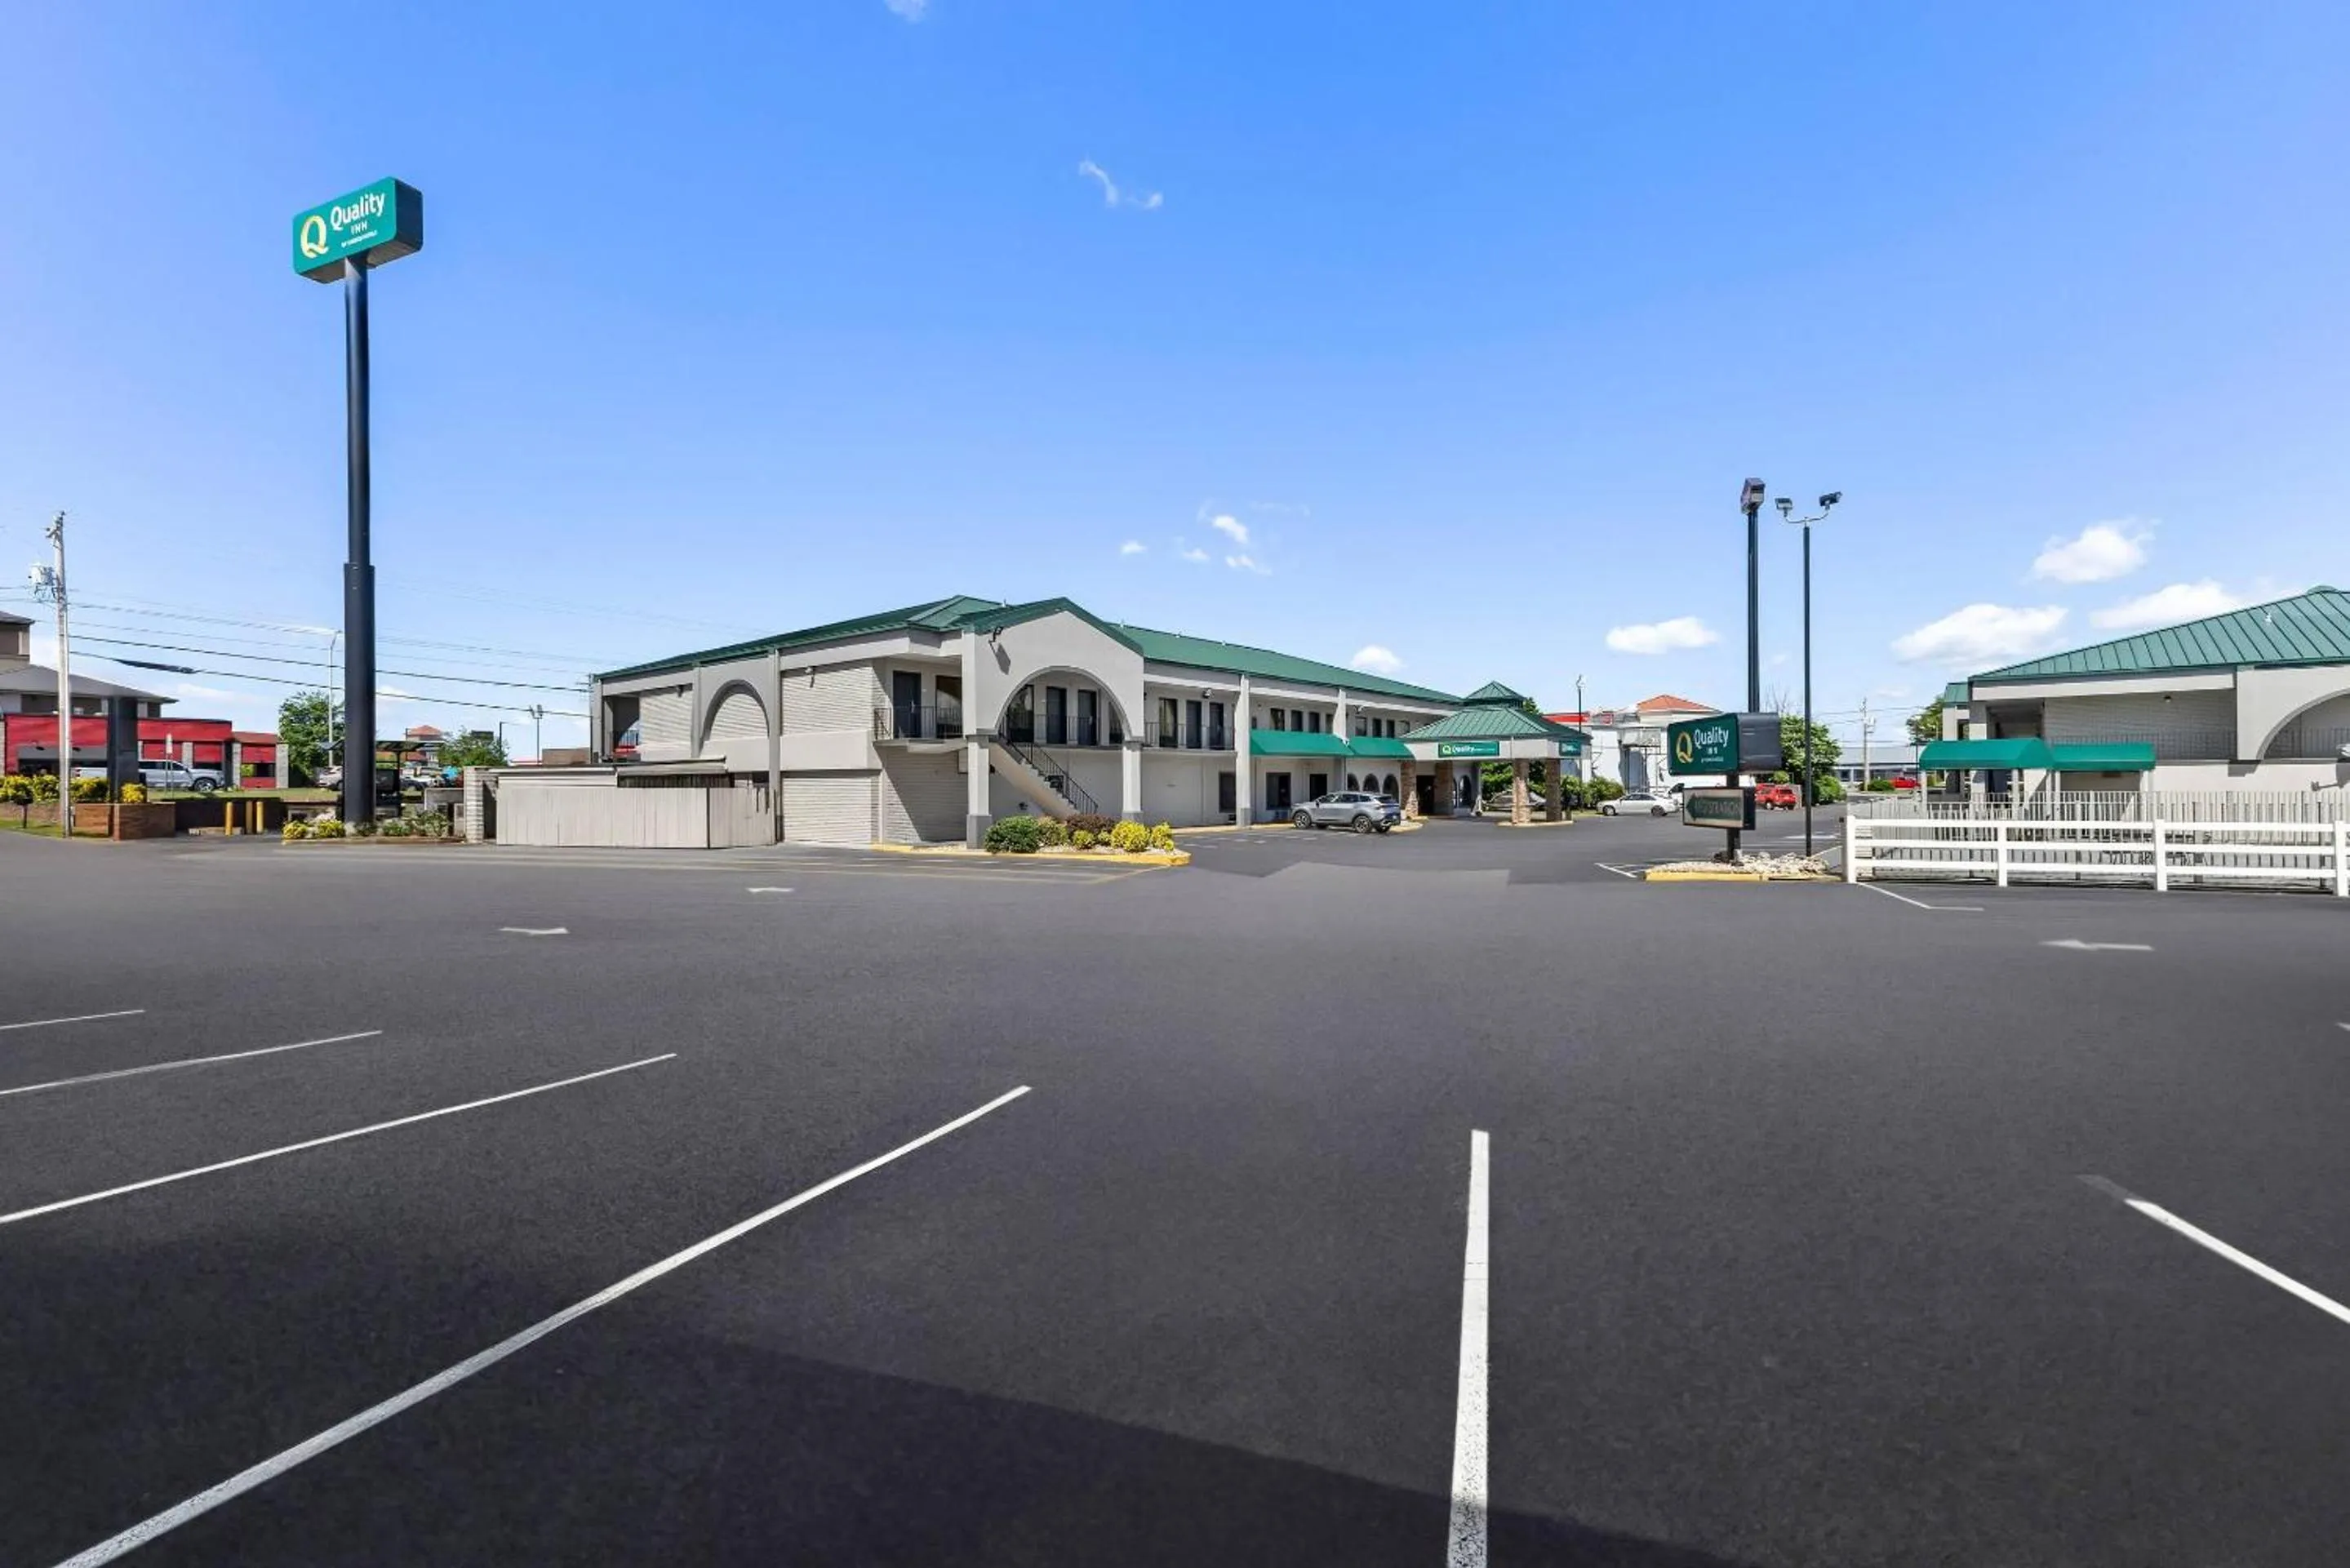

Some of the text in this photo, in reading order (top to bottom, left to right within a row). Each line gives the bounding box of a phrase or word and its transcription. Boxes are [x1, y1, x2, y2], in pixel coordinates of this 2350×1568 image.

[331, 193, 385, 231] Quality
[300, 215, 329, 259] Q
[1676, 731, 1694, 764] Q
[1693, 726, 1729, 749] Quality
